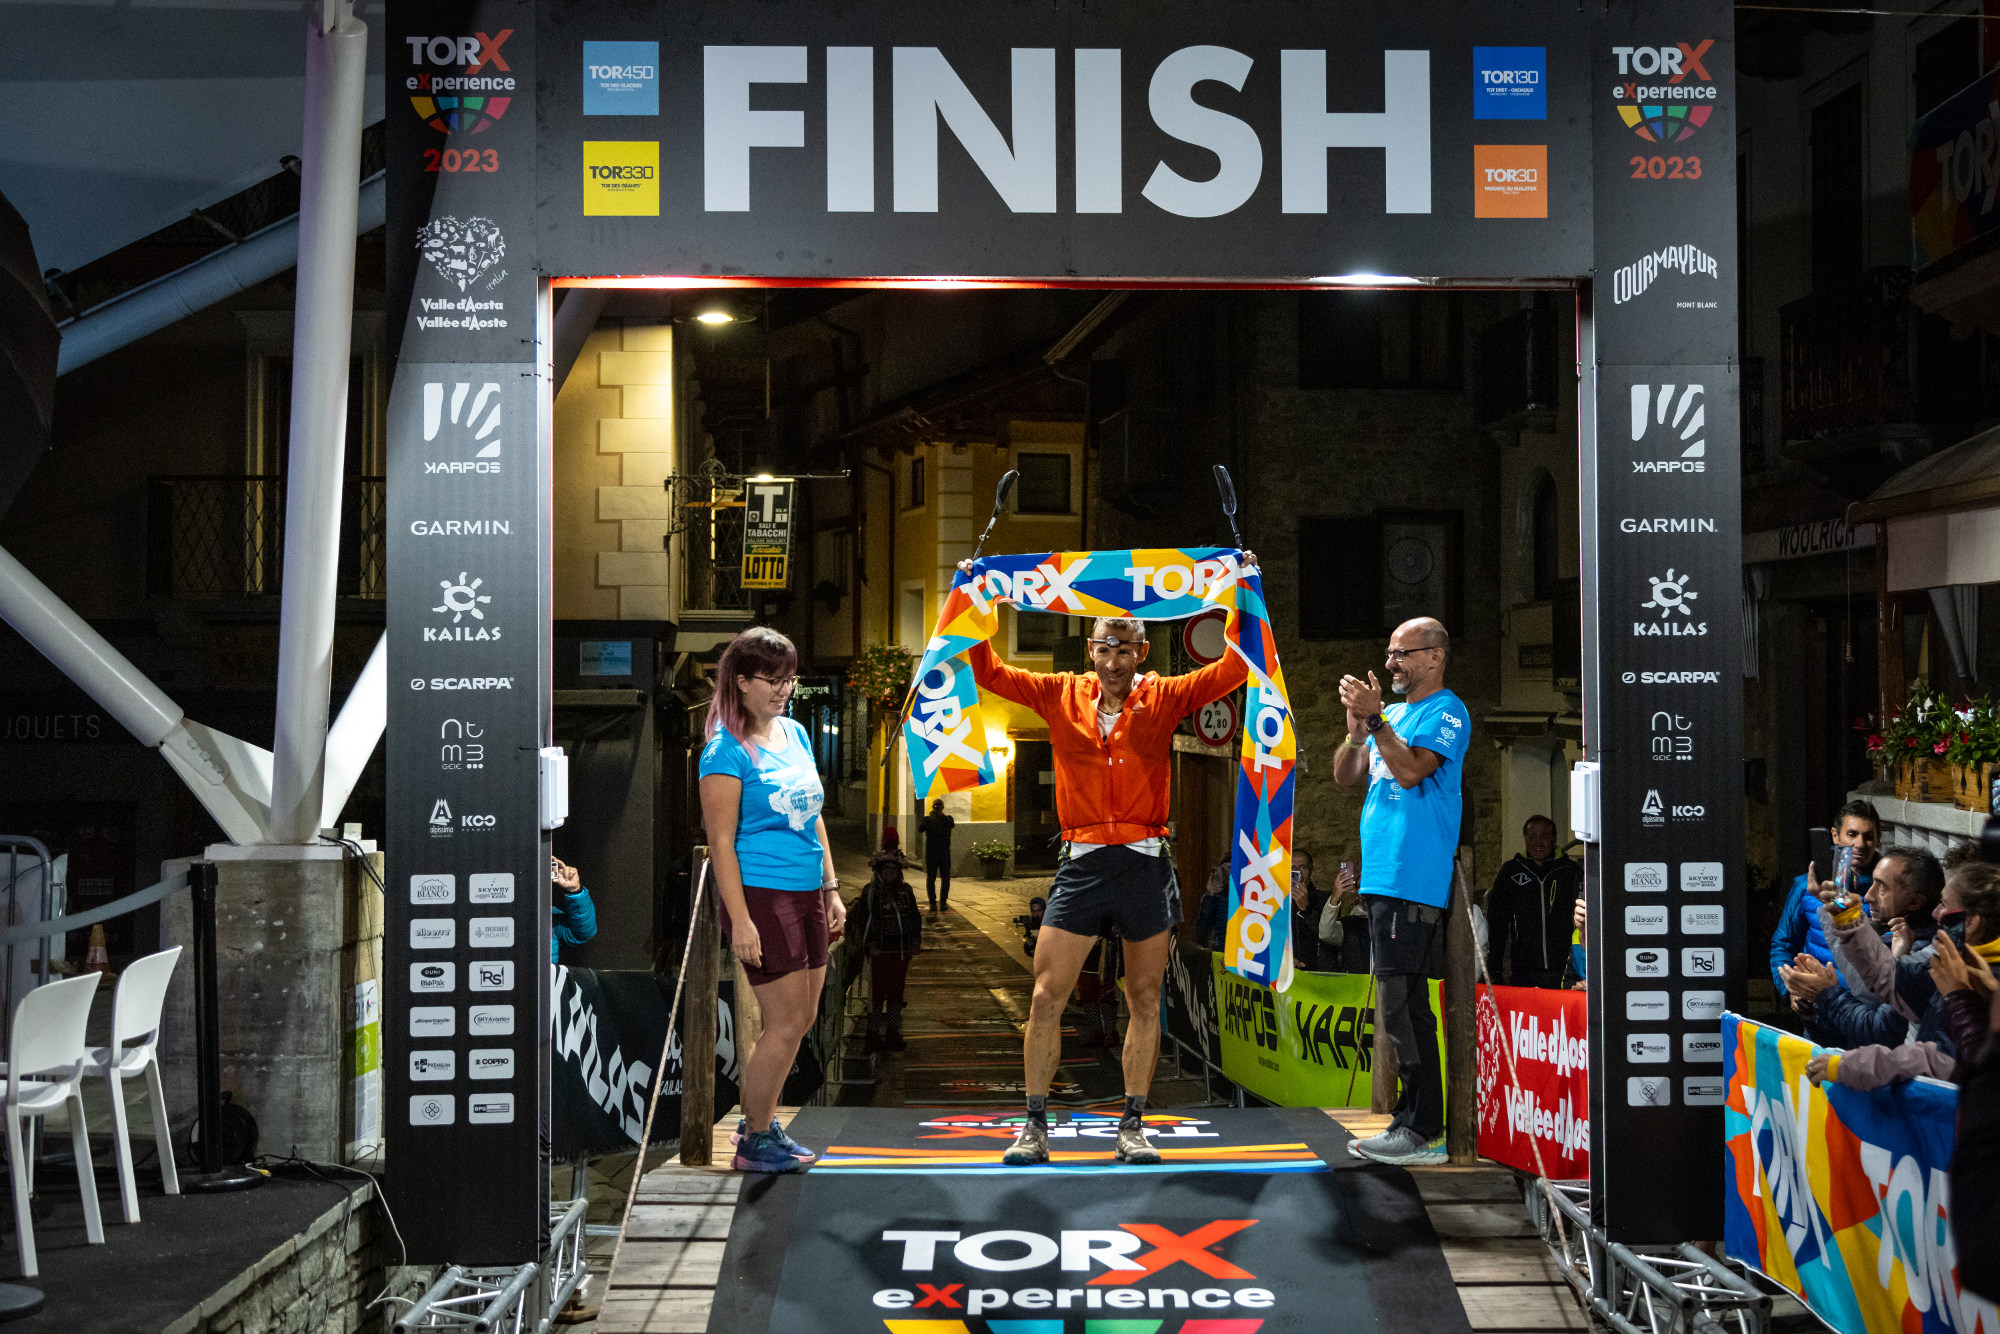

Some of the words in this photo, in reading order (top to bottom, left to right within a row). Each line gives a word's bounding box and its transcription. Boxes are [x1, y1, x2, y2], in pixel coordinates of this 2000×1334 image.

[406, 29, 514, 74] TORX
[1612, 39, 1715, 84] TORX
[588, 66, 654, 79] TOR450
[1481, 70, 1538, 84] TOR130
[406, 74, 515, 94] eXperience
[1613, 83, 1716, 102] eXperience
[704, 44, 1432, 218] FINISH
[423, 149, 500, 172] 2023
[1630, 156, 1702, 180] 2023
[588, 166, 654, 180] TOR330
[1484, 168, 1537, 182] TOR30
[1614, 244, 1718, 304] COURMAYEUR
[421, 298, 455, 312] Valle
[457, 296, 504, 312] d'Aosta
[417, 316, 460, 331] Vallée
[461, 314, 508, 331] d'Aoste
[424, 462, 501, 474] KARPOS
[1632, 461, 1705, 473] KARPOS
[754, 486, 784, 522] T
[411, 520, 510, 535] GARMIN
[747, 529, 786, 537] TABACCHI
[1620, 518, 1714, 533] GARMIN
[1777, 519, 1855, 557] WOOLRICH
[745, 556, 784, 580] LOTTO
[960, 558, 1093, 616] TORX
[424, 627, 501, 642] KAILAS
[1634, 622, 1708, 636] KAILAS
[430, 677, 512, 690] SCARPA
[1641, 672, 1718, 684] SCARPA
[4, 715, 101, 740] JOUETS
[909, 662, 986, 778] ORX
[1204, 710, 1227, 730] 2,80
[1631, 878, 1661, 886] BIANCO
[417, 890, 449, 898] BIANCO
[1236, 828, 1284, 978] TORX
[1510, 1010, 1547, 1069] Valle
[1504, 1084, 1553, 1145] Vallée
[882, 1219, 1260, 1285] TORX
[872, 1284, 1275, 1315] eXperience
